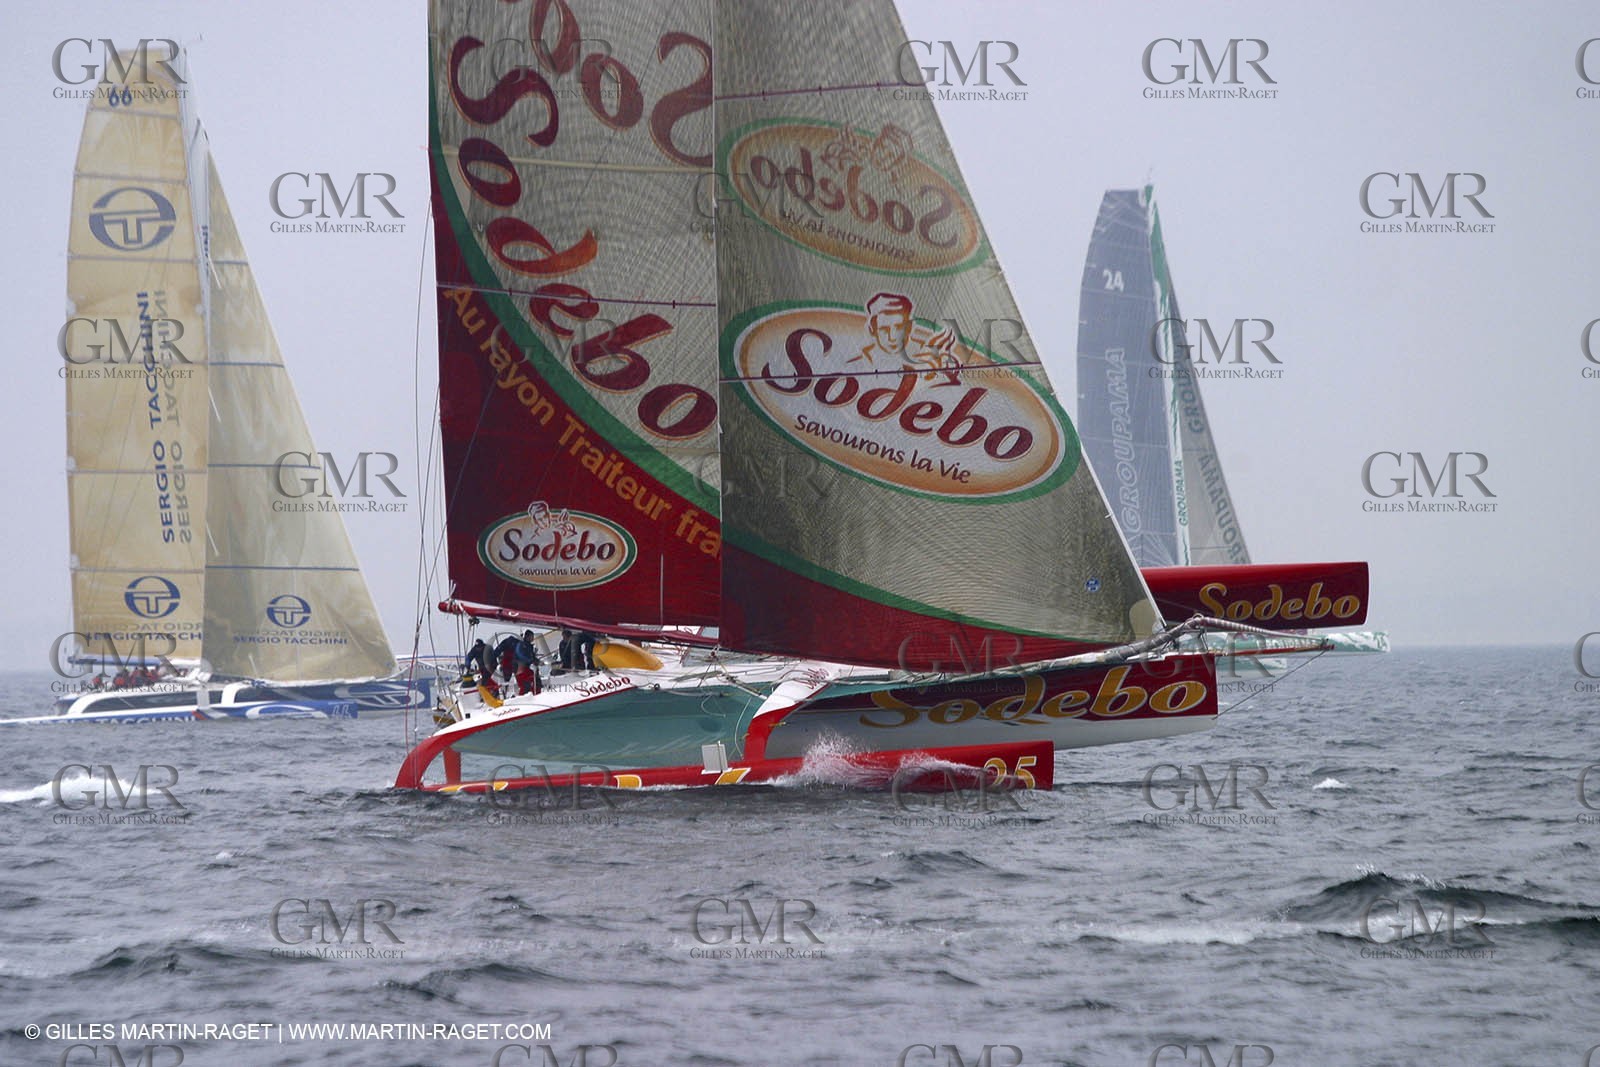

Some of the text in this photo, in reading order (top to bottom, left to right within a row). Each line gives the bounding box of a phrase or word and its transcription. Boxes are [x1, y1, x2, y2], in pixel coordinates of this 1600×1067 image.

[108, 84, 133, 107] 66
[446, 36, 719, 440] Sodebo
[1102, 269, 1125, 293] 24
[443, 287, 486, 335] Au
[479, 337, 556, 426] rayon
[557, 413, 672, 522] Traiteur
[761, 328, 1034, 461] Sodebo
[136, 291, 175, 543] SERGIO TACCHINI
[1104, 347, 1143, 534] GROUPAMA
[910, 450, 934, 472] la
[1173, 459, 1188, 526] GROUPAMA
[498, 528, 616, 562] Sodebo
[569, 566, 580, 576] la
[1200, 581, 1360, 621] Sodebo
[233, 635, 348, 645] SERGIO TACCHINI
[574, 675, 632, 698] Sodebo
[859, 665, 1207, 728] Sodebo
[984, 755, 1037, 790] 25
